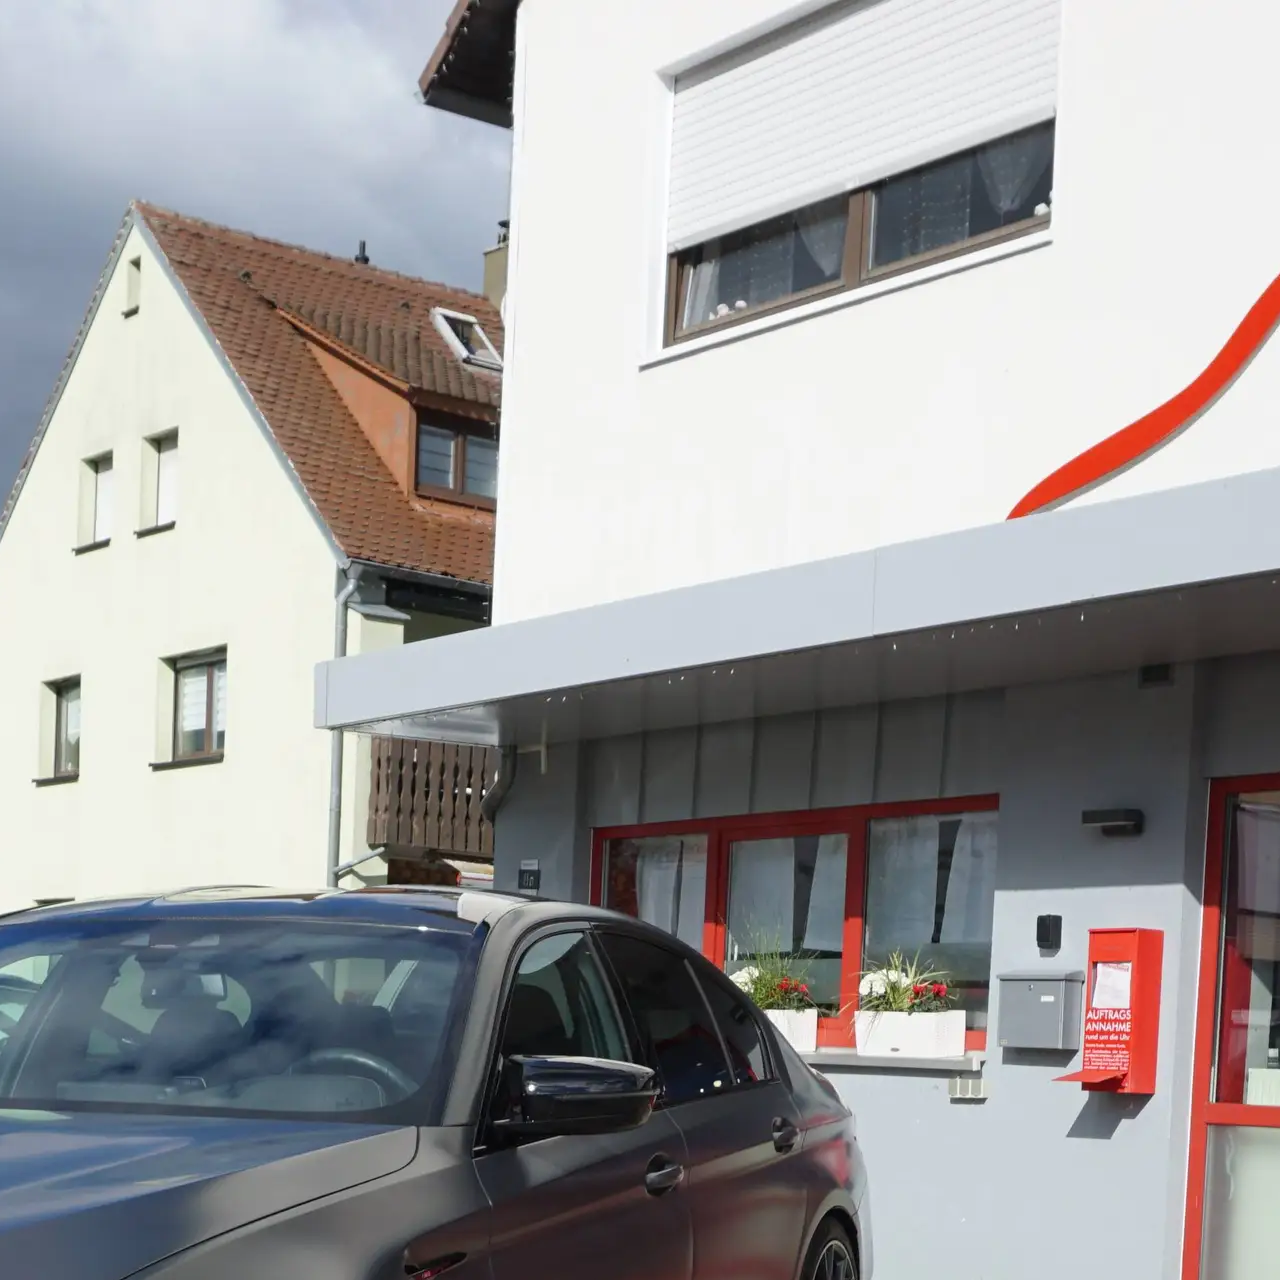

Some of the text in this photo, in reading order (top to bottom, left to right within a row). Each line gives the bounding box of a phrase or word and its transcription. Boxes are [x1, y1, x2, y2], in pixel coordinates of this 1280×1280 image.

[1086, 1009, 1131, 1020] AUFTRAGS
[1085, 1021, 1131, 1033] ANNAHME
[1085, 1033, 1098, 1041] rund
[1109, 1033, 1119, 1041] die
